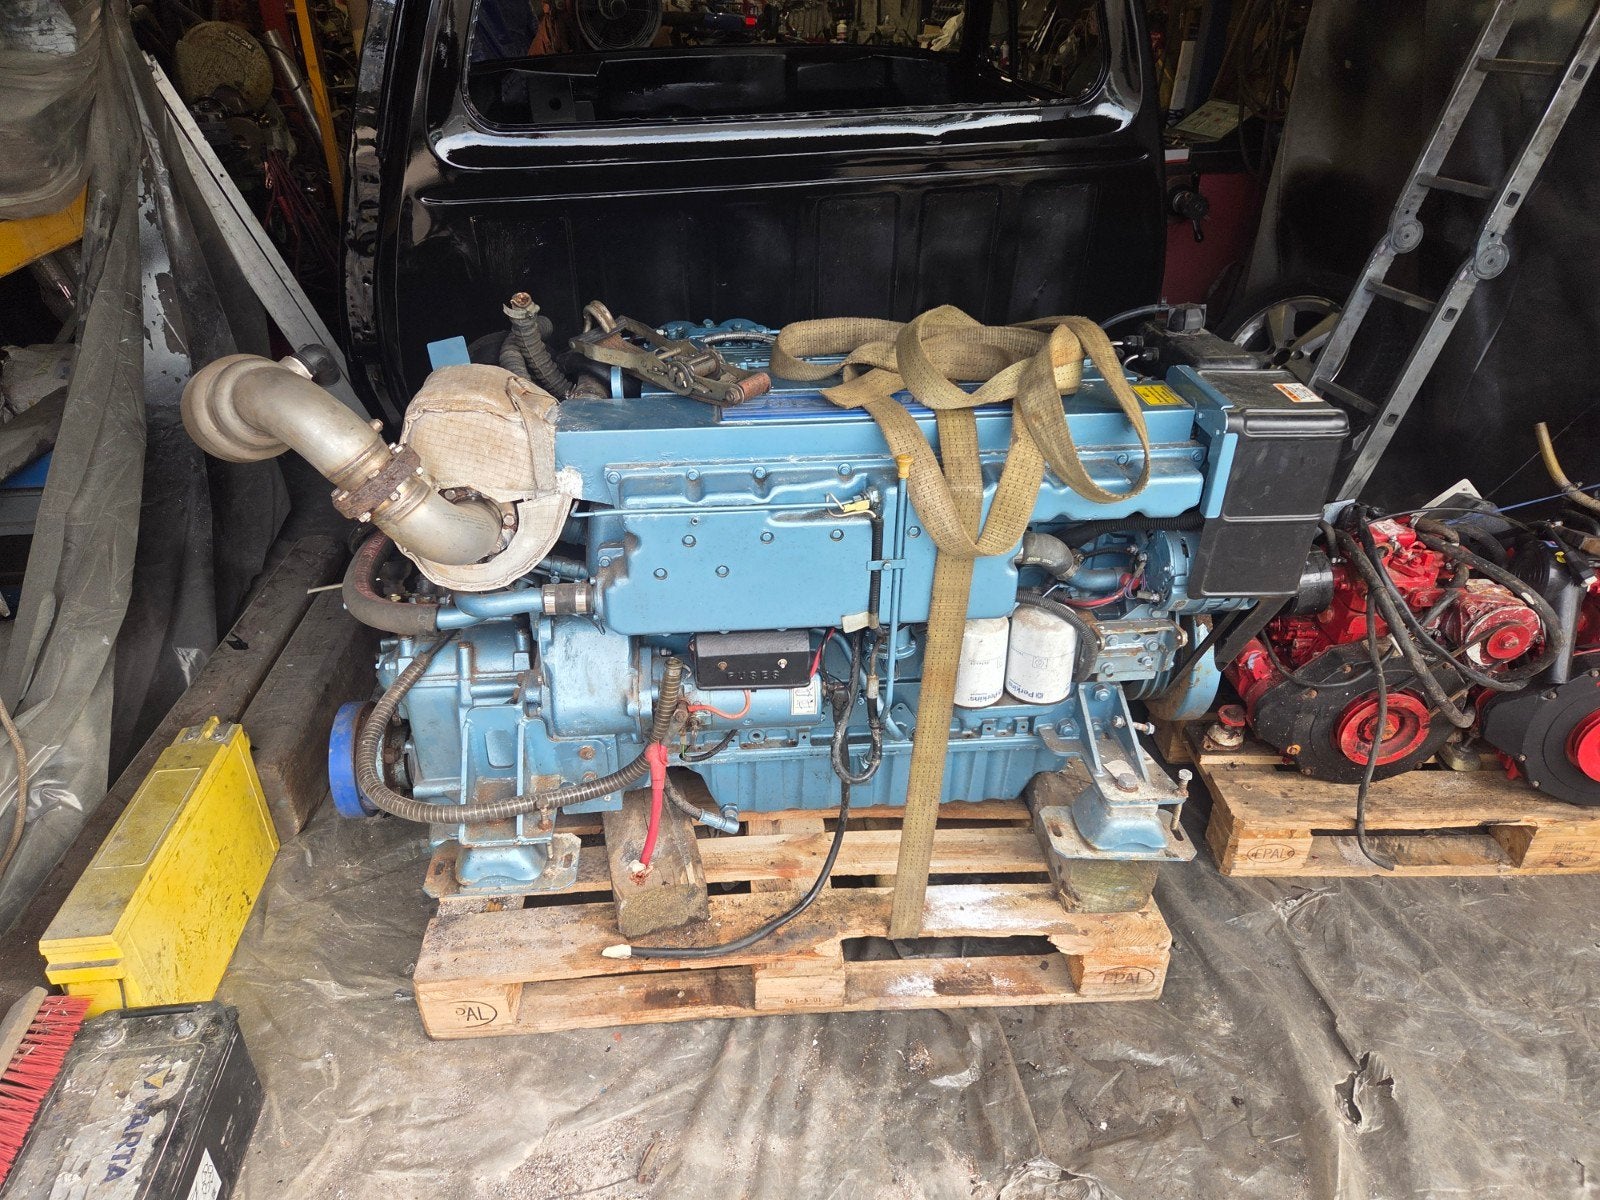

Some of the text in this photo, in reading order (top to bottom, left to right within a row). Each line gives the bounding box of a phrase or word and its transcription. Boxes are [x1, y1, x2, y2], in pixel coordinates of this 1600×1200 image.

[727, 669, 780, 680] FUSES
[1255, 848, 1286, 859] EPAL
[455, 1006, 490, 1021] PAL
